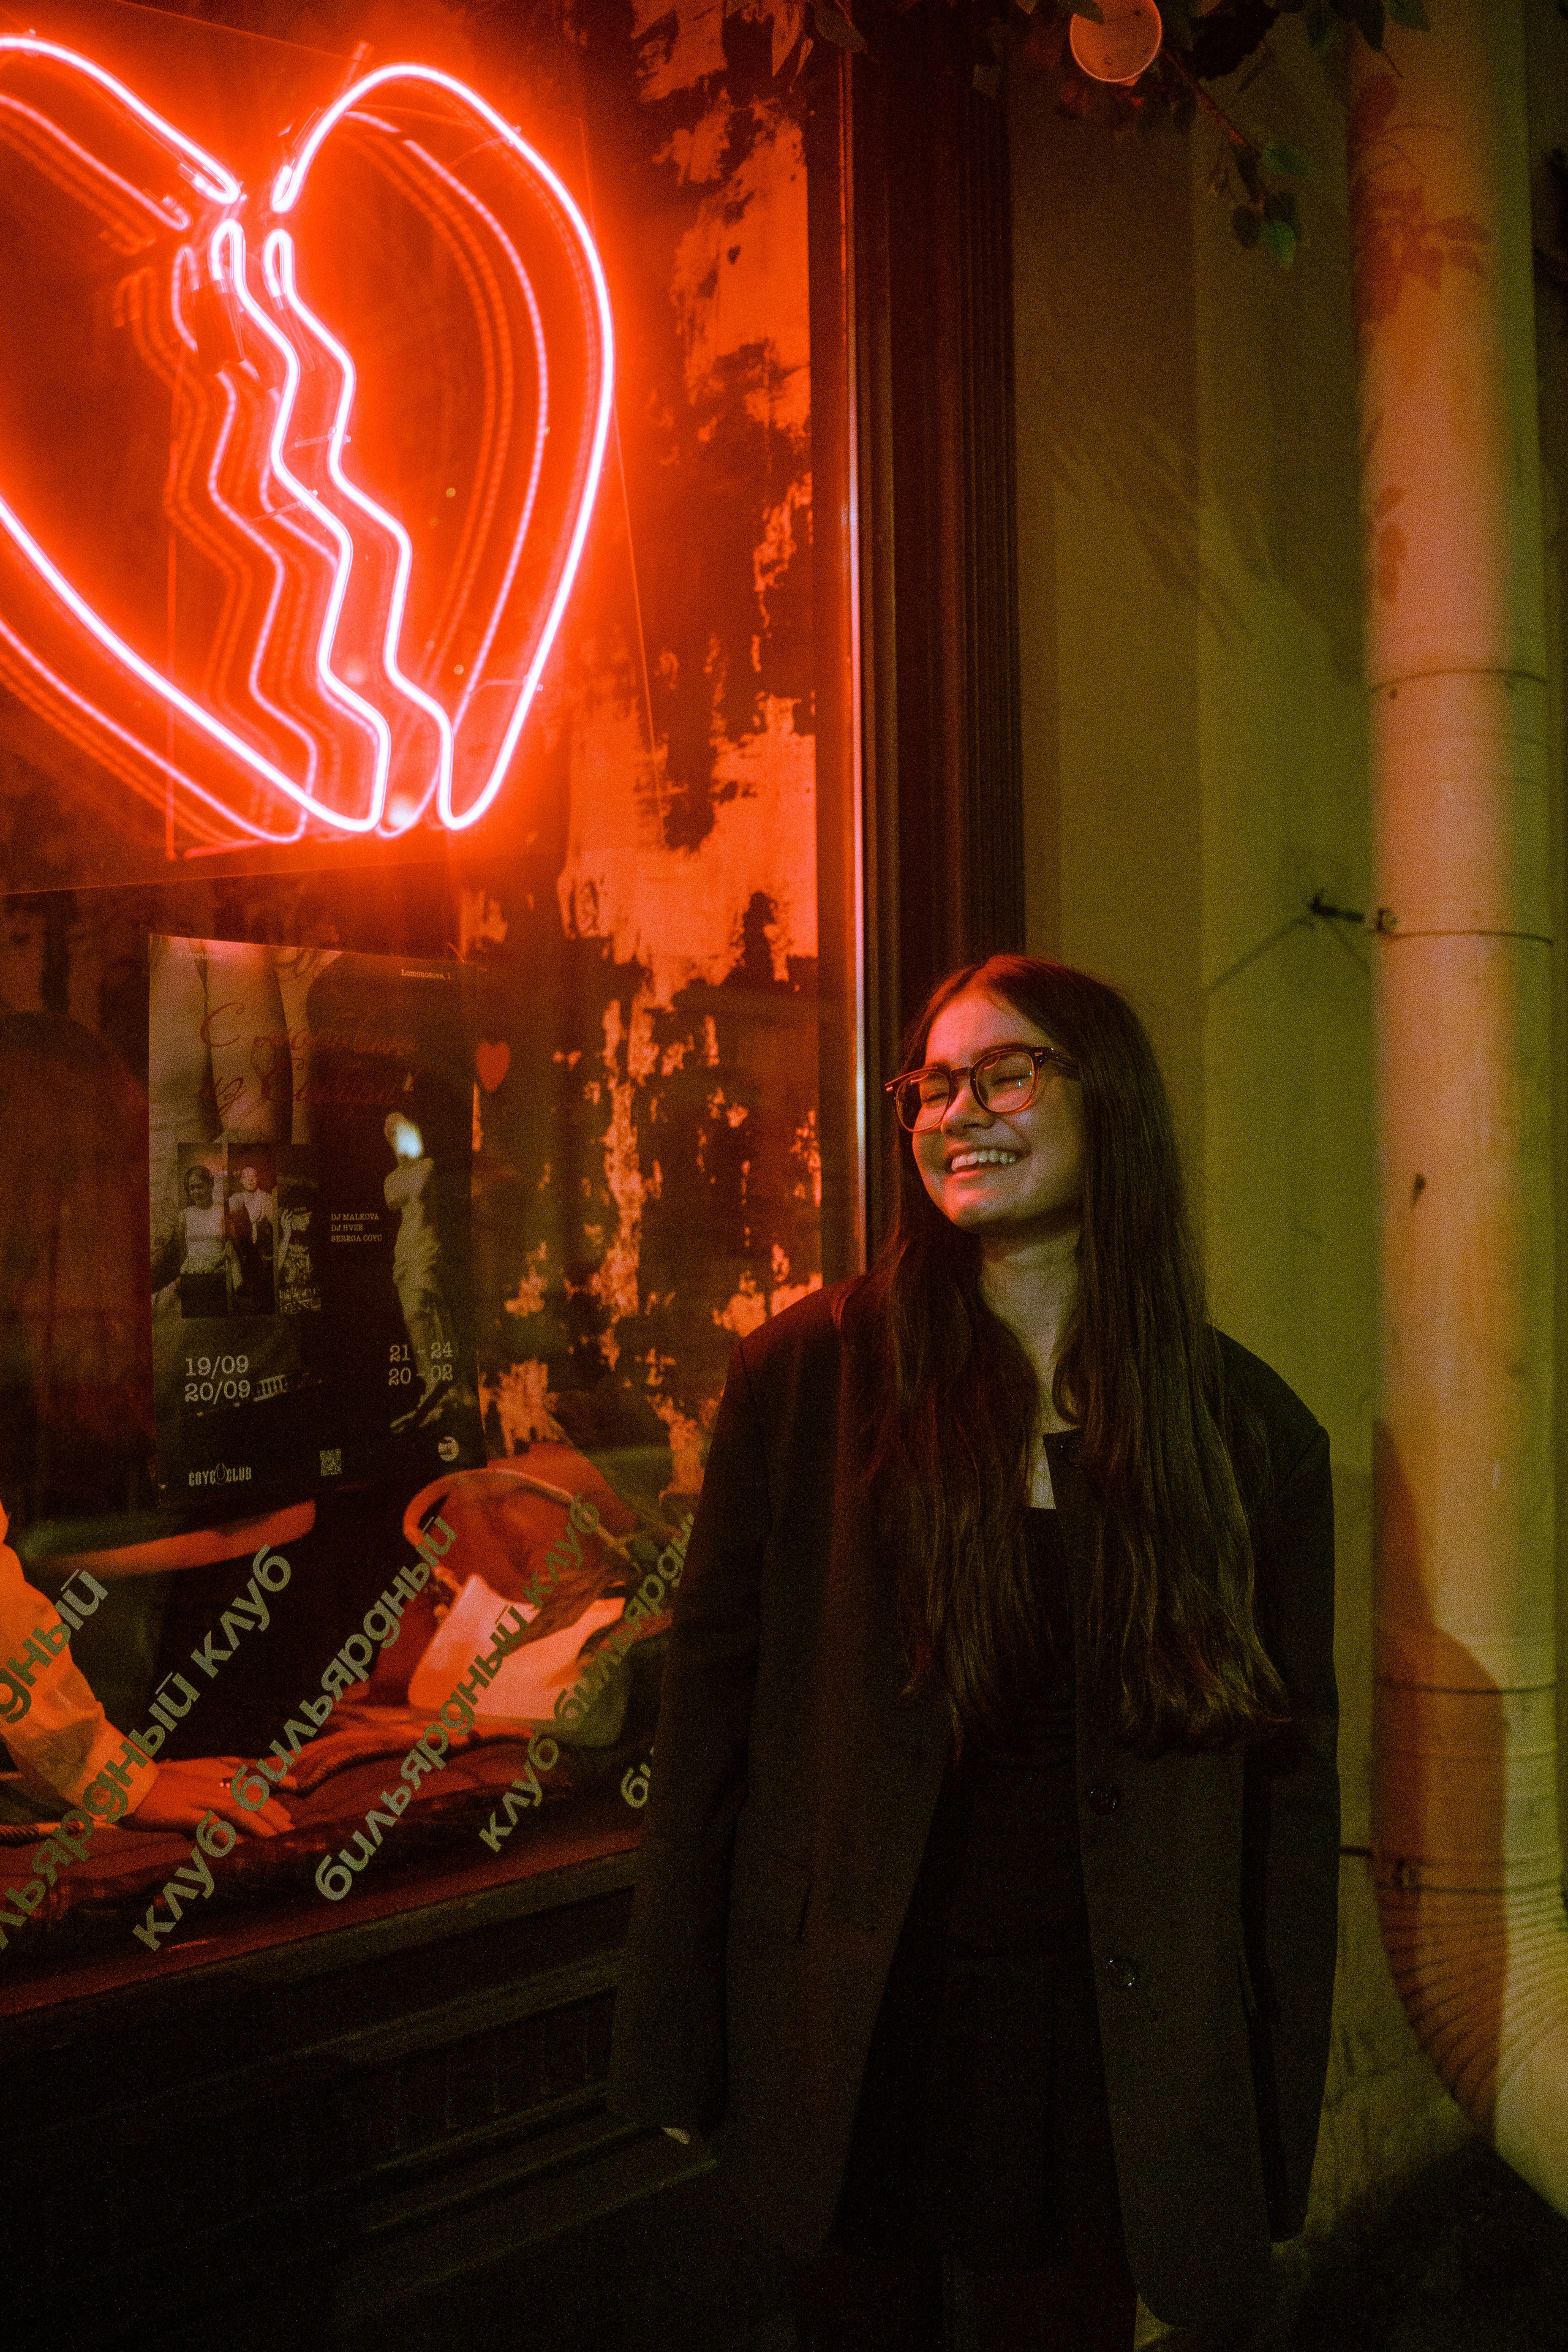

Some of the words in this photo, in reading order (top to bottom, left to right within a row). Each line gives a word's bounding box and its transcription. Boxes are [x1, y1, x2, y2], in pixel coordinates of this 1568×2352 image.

[388, 1343, 411, 1363] 21
[430, 1340, 453, 1359] 24
[185, 1354, 250, 1380] 19/09
[388, 1366, 412, 1387] 20
[430, 1363, 454, 1382] 02
[184, 1379, 251, 1404] 20/09
[226, 1466, 252, 1483] CLUB
[190, 1544, 292, 1679] клуб
[314, 1605, 530, 1901] бильярдный
[522, 1493, 600, 1615] клуб
[132, 1810, 237, 1951] клуб
[230, 1515, 458, 1812] бильярдный
[478, 1733, 560, 1853] клуб
